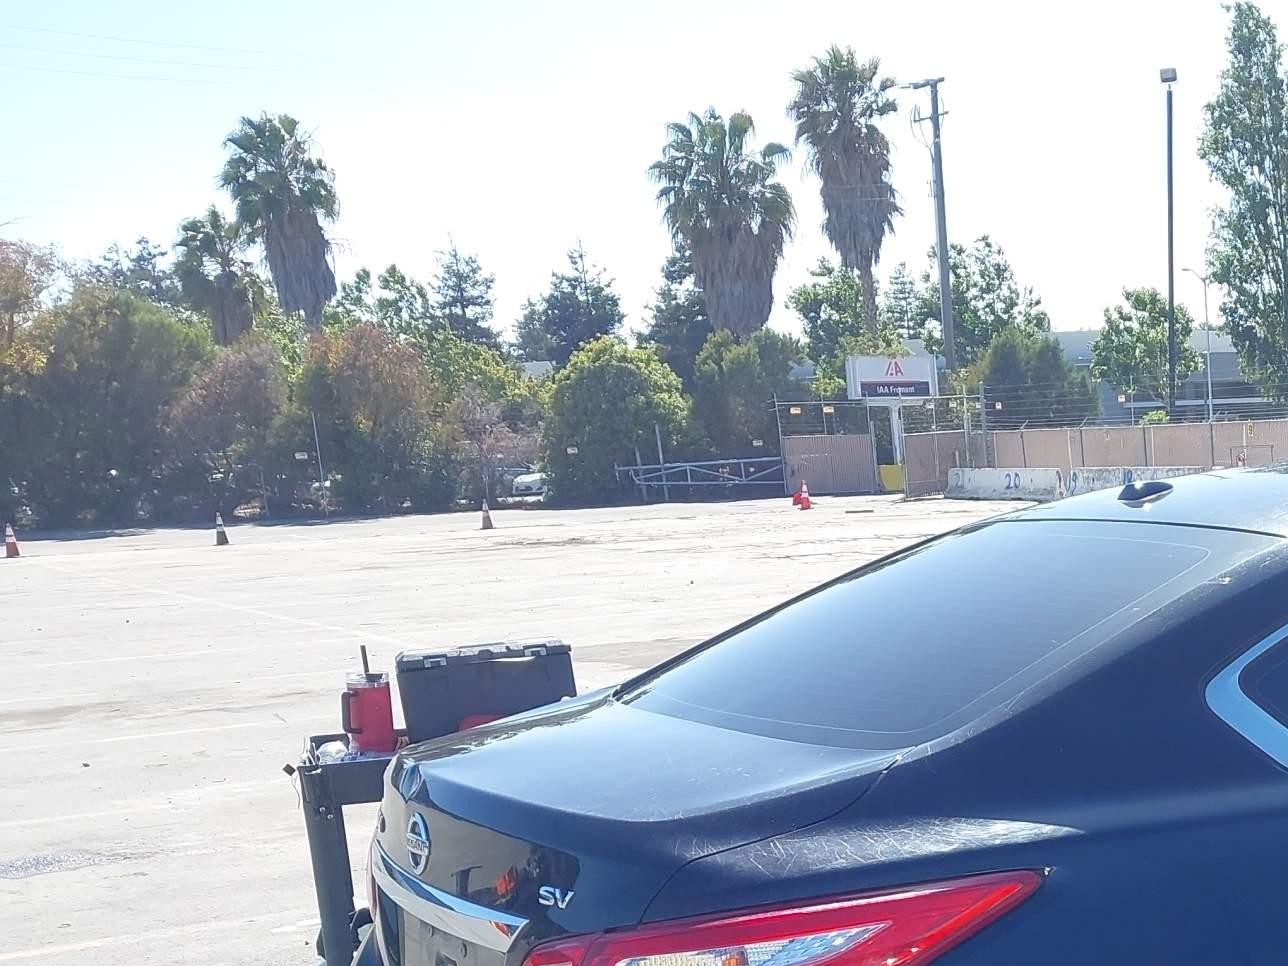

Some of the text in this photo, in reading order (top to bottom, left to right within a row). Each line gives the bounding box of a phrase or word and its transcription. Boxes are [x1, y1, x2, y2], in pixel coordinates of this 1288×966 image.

[876, 385, 889, 394] IAA
[1004, 471, 1021, 490] 20
[536, 885, 575, 909] SV
